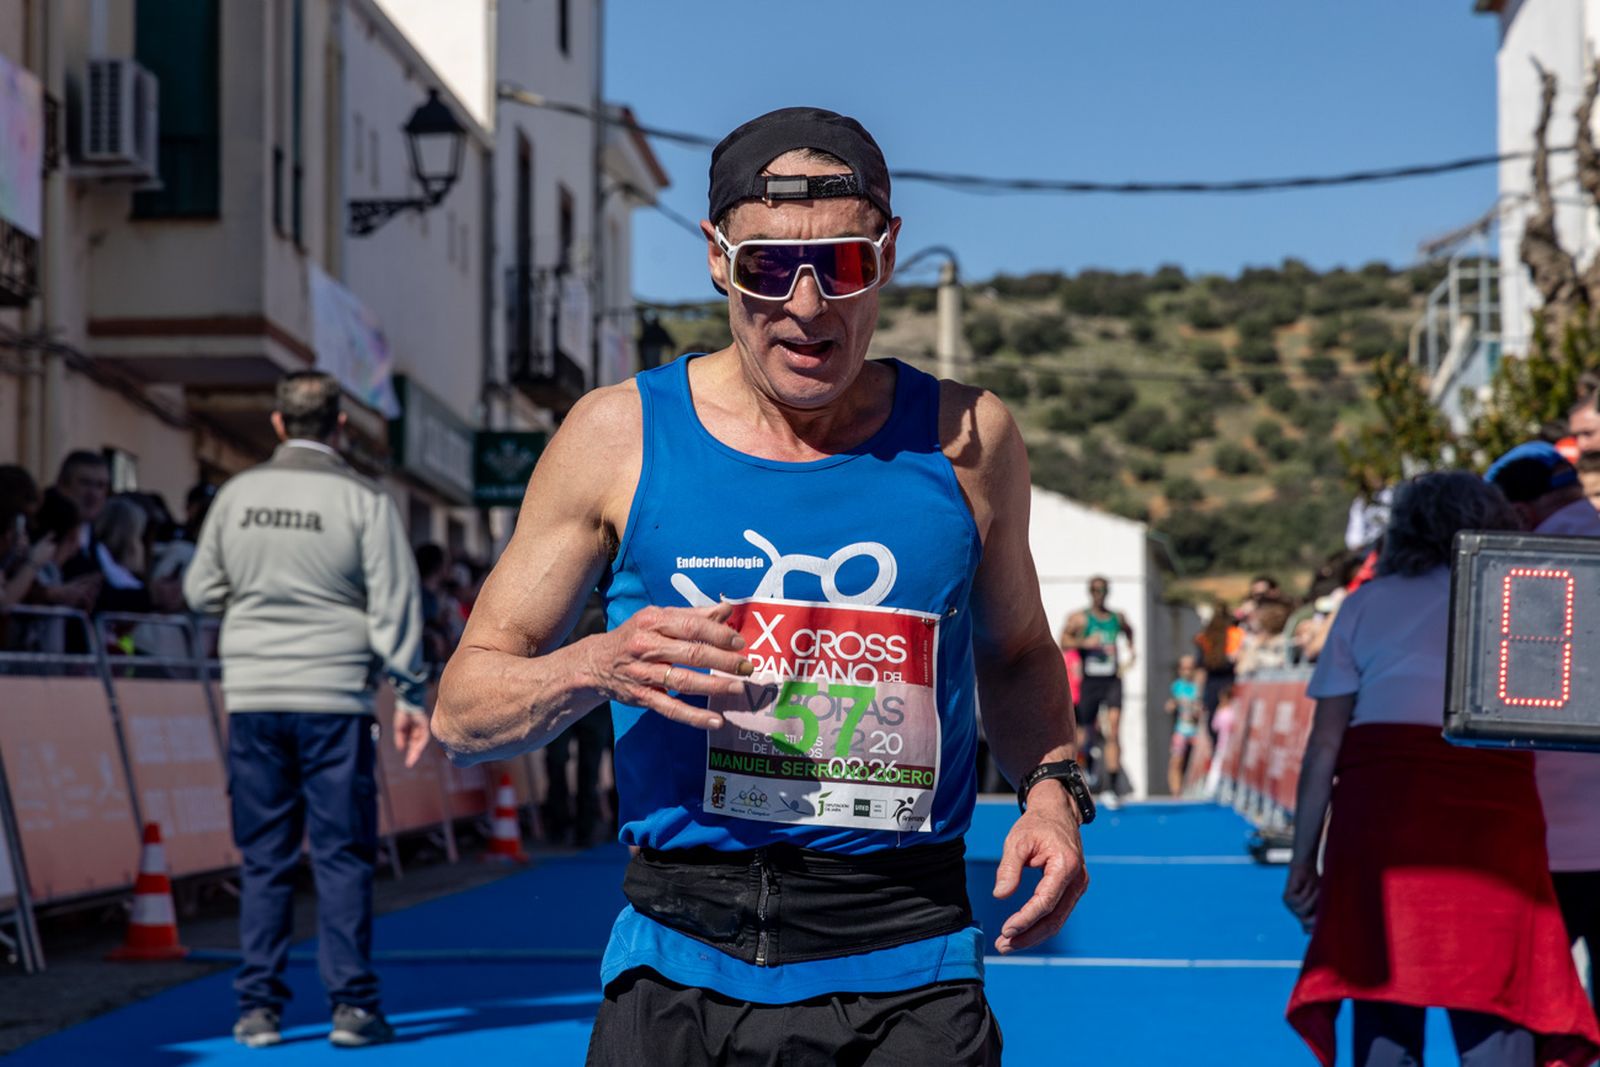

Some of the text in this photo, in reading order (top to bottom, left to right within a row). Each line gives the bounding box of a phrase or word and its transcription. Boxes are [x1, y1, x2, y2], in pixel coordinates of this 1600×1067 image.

[676, 556, 764, 569] Endocrinología
[749, 611, 785, 653] X
[790, 628, 907, 664] CROSS
[1499, 568, 1574, 708] 0
[748, 653, 907, 687] PANTANO DEL
[738, 729, 760, 742] LAS
[770, 681, 876, 757] 57
[752, 743, 768, 755] DE
[869, 730, 903, 755] 20
[710, 752, 934, 786] MANUEL SERRANO QUERO
